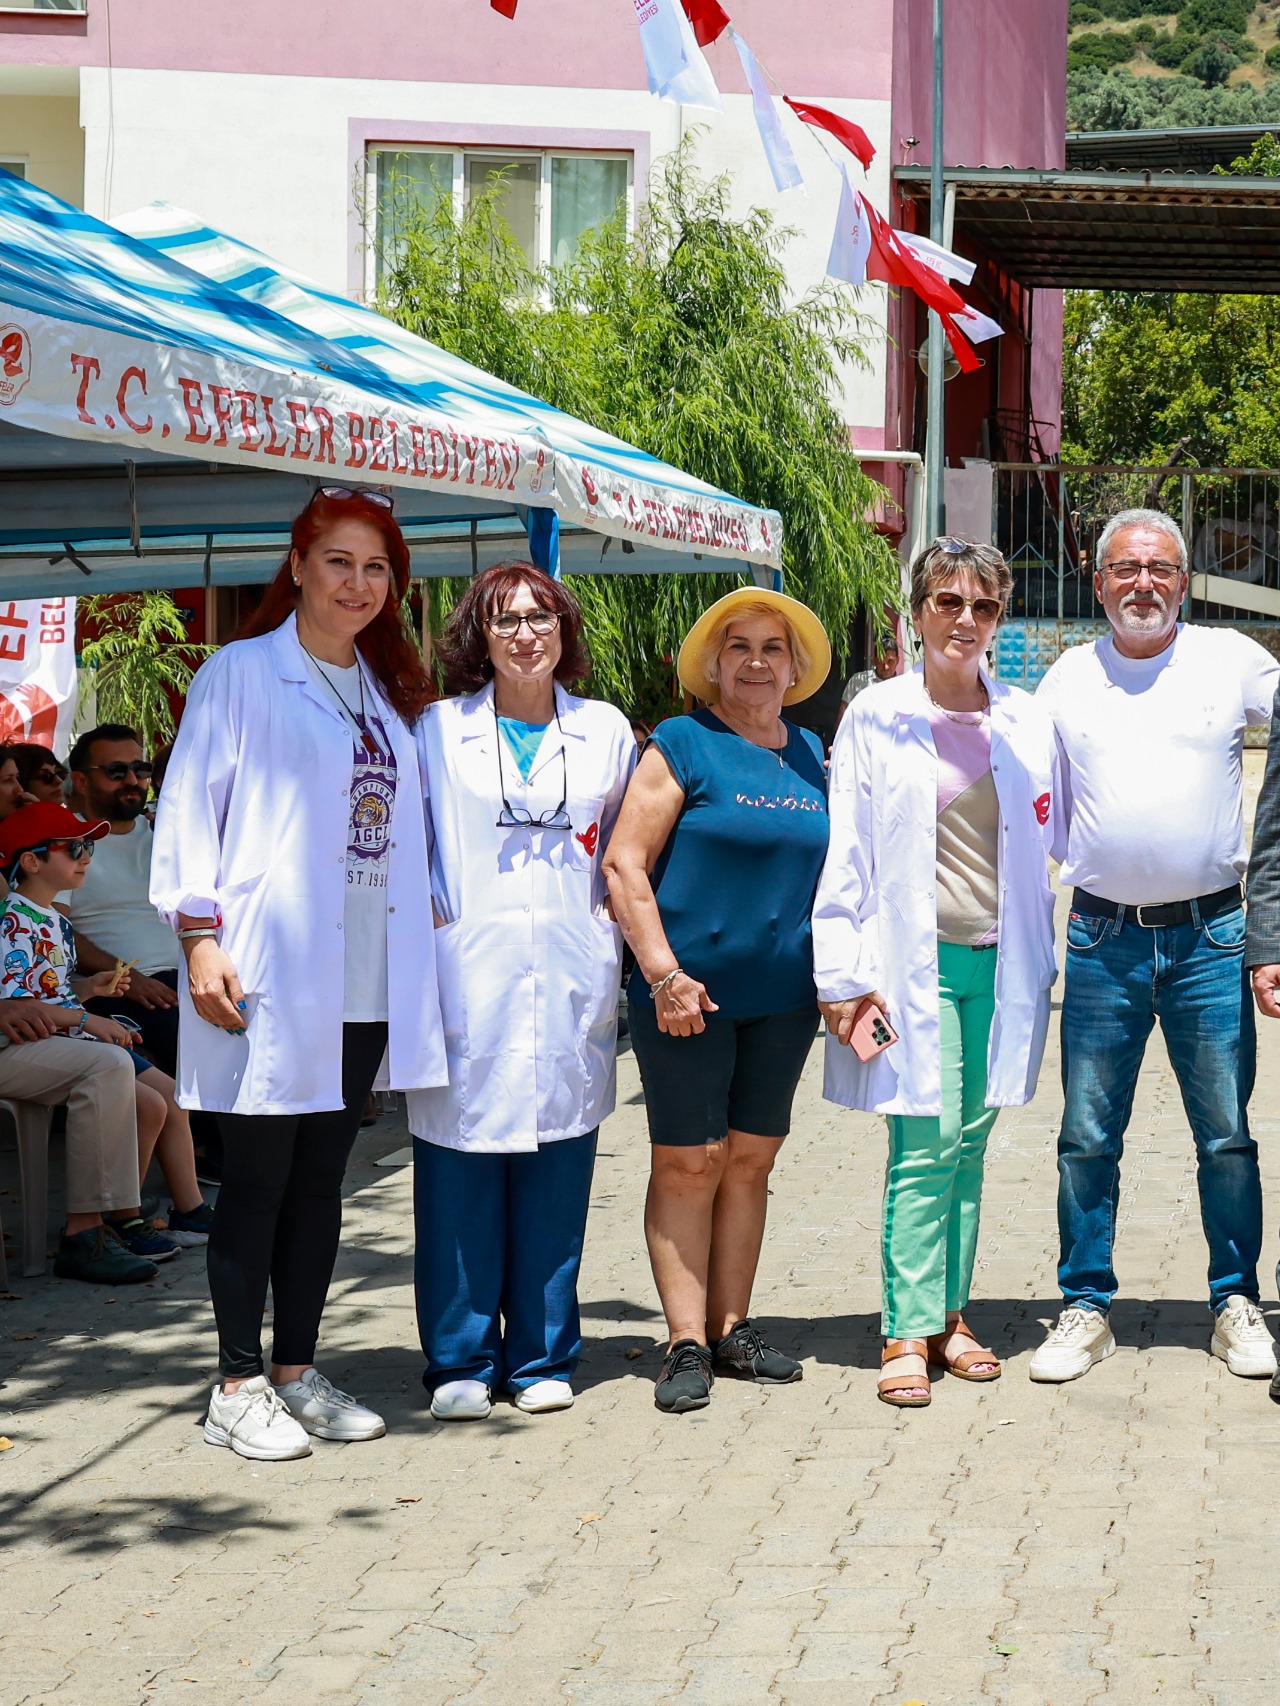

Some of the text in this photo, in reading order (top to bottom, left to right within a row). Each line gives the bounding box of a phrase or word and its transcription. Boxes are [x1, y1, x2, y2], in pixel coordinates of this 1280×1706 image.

[71, 353, 520, 491] T.C. EFELER BELEDİYESİ
